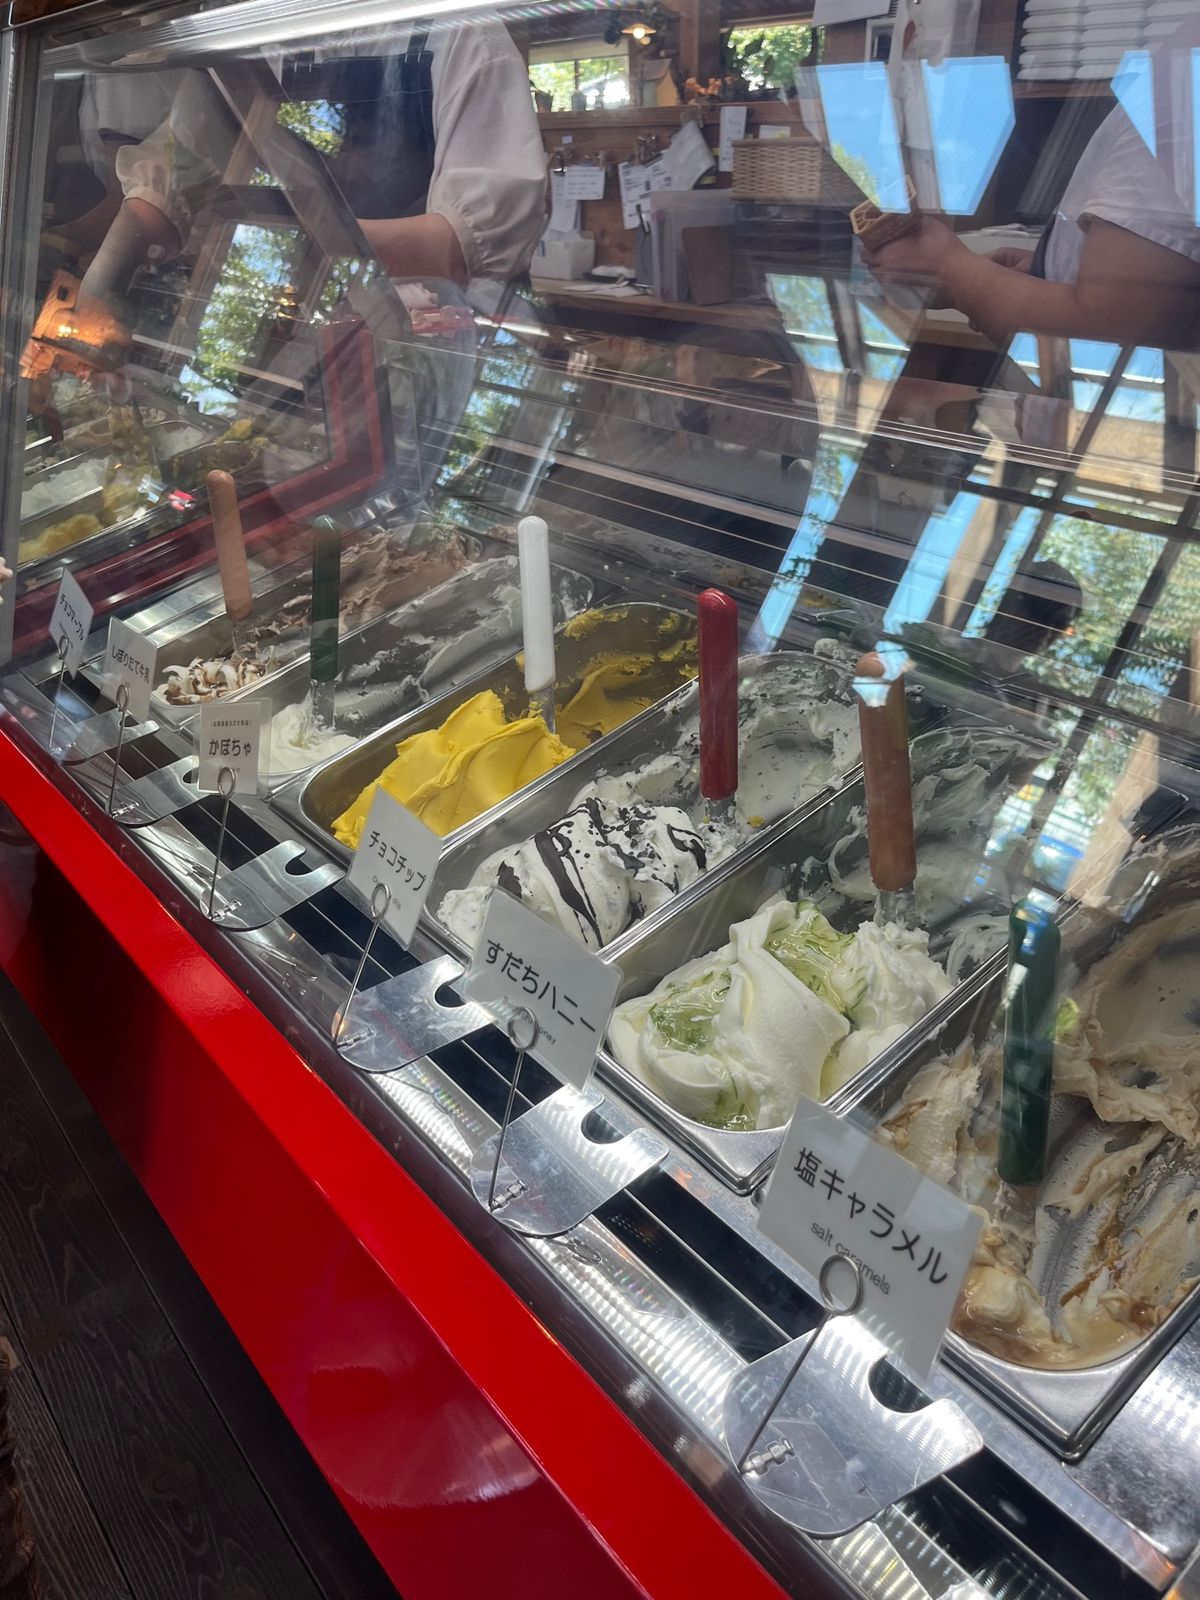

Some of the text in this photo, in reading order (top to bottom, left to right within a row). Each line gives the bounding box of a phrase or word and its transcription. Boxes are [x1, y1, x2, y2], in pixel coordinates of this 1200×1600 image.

[208, 738, 252, 757] かぼちゃ
[368, 830, 427, 892] チョコチップ
[485, 938, 597, 1034] すだちハニー
[793, 1146, 949, 1285] 塩キャラメル
[811, 1221, 834, 1247] salt
